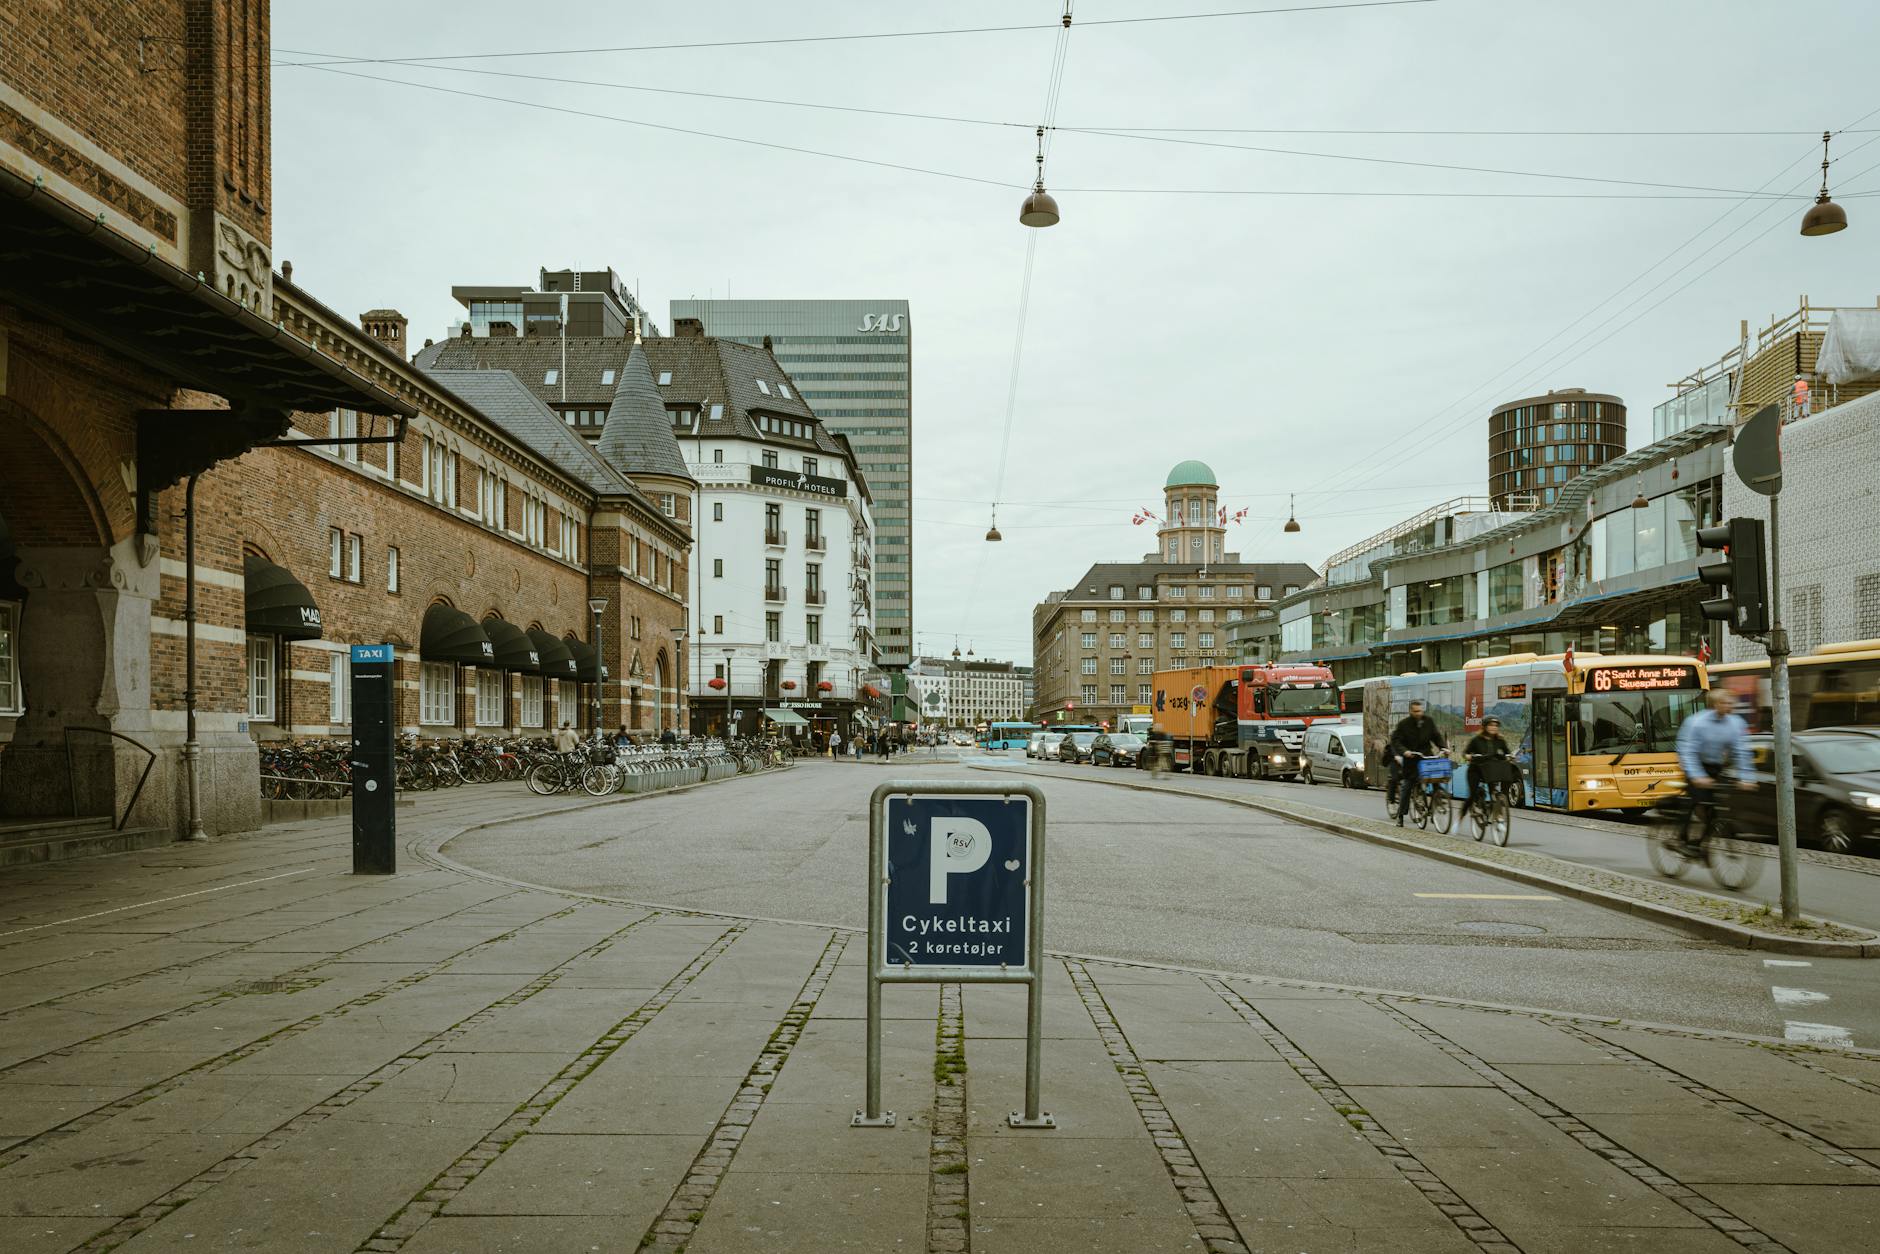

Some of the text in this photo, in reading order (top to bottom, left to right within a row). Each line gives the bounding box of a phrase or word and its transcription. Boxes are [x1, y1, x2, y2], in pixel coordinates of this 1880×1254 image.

[857, 313, 905, 332] SAS
[765, 476, 836, 495] PROFIL HOTELS
[358, 650, 383, 658] TAXI
[1594, 669, 1612, 691] 66
[1611, 669, 1637, 680] Sankt
[1662, 667, 1687, 678] Plads
[1619, 677, 1680, 689] Skuespilhuset
[1624, 768, 1641, 776] DOT
[930, 816, 992, 905] P
[902, 915, 1011, 935] Cykeltaxi
[909, 941, 1004, 957] 2 køretøjer
